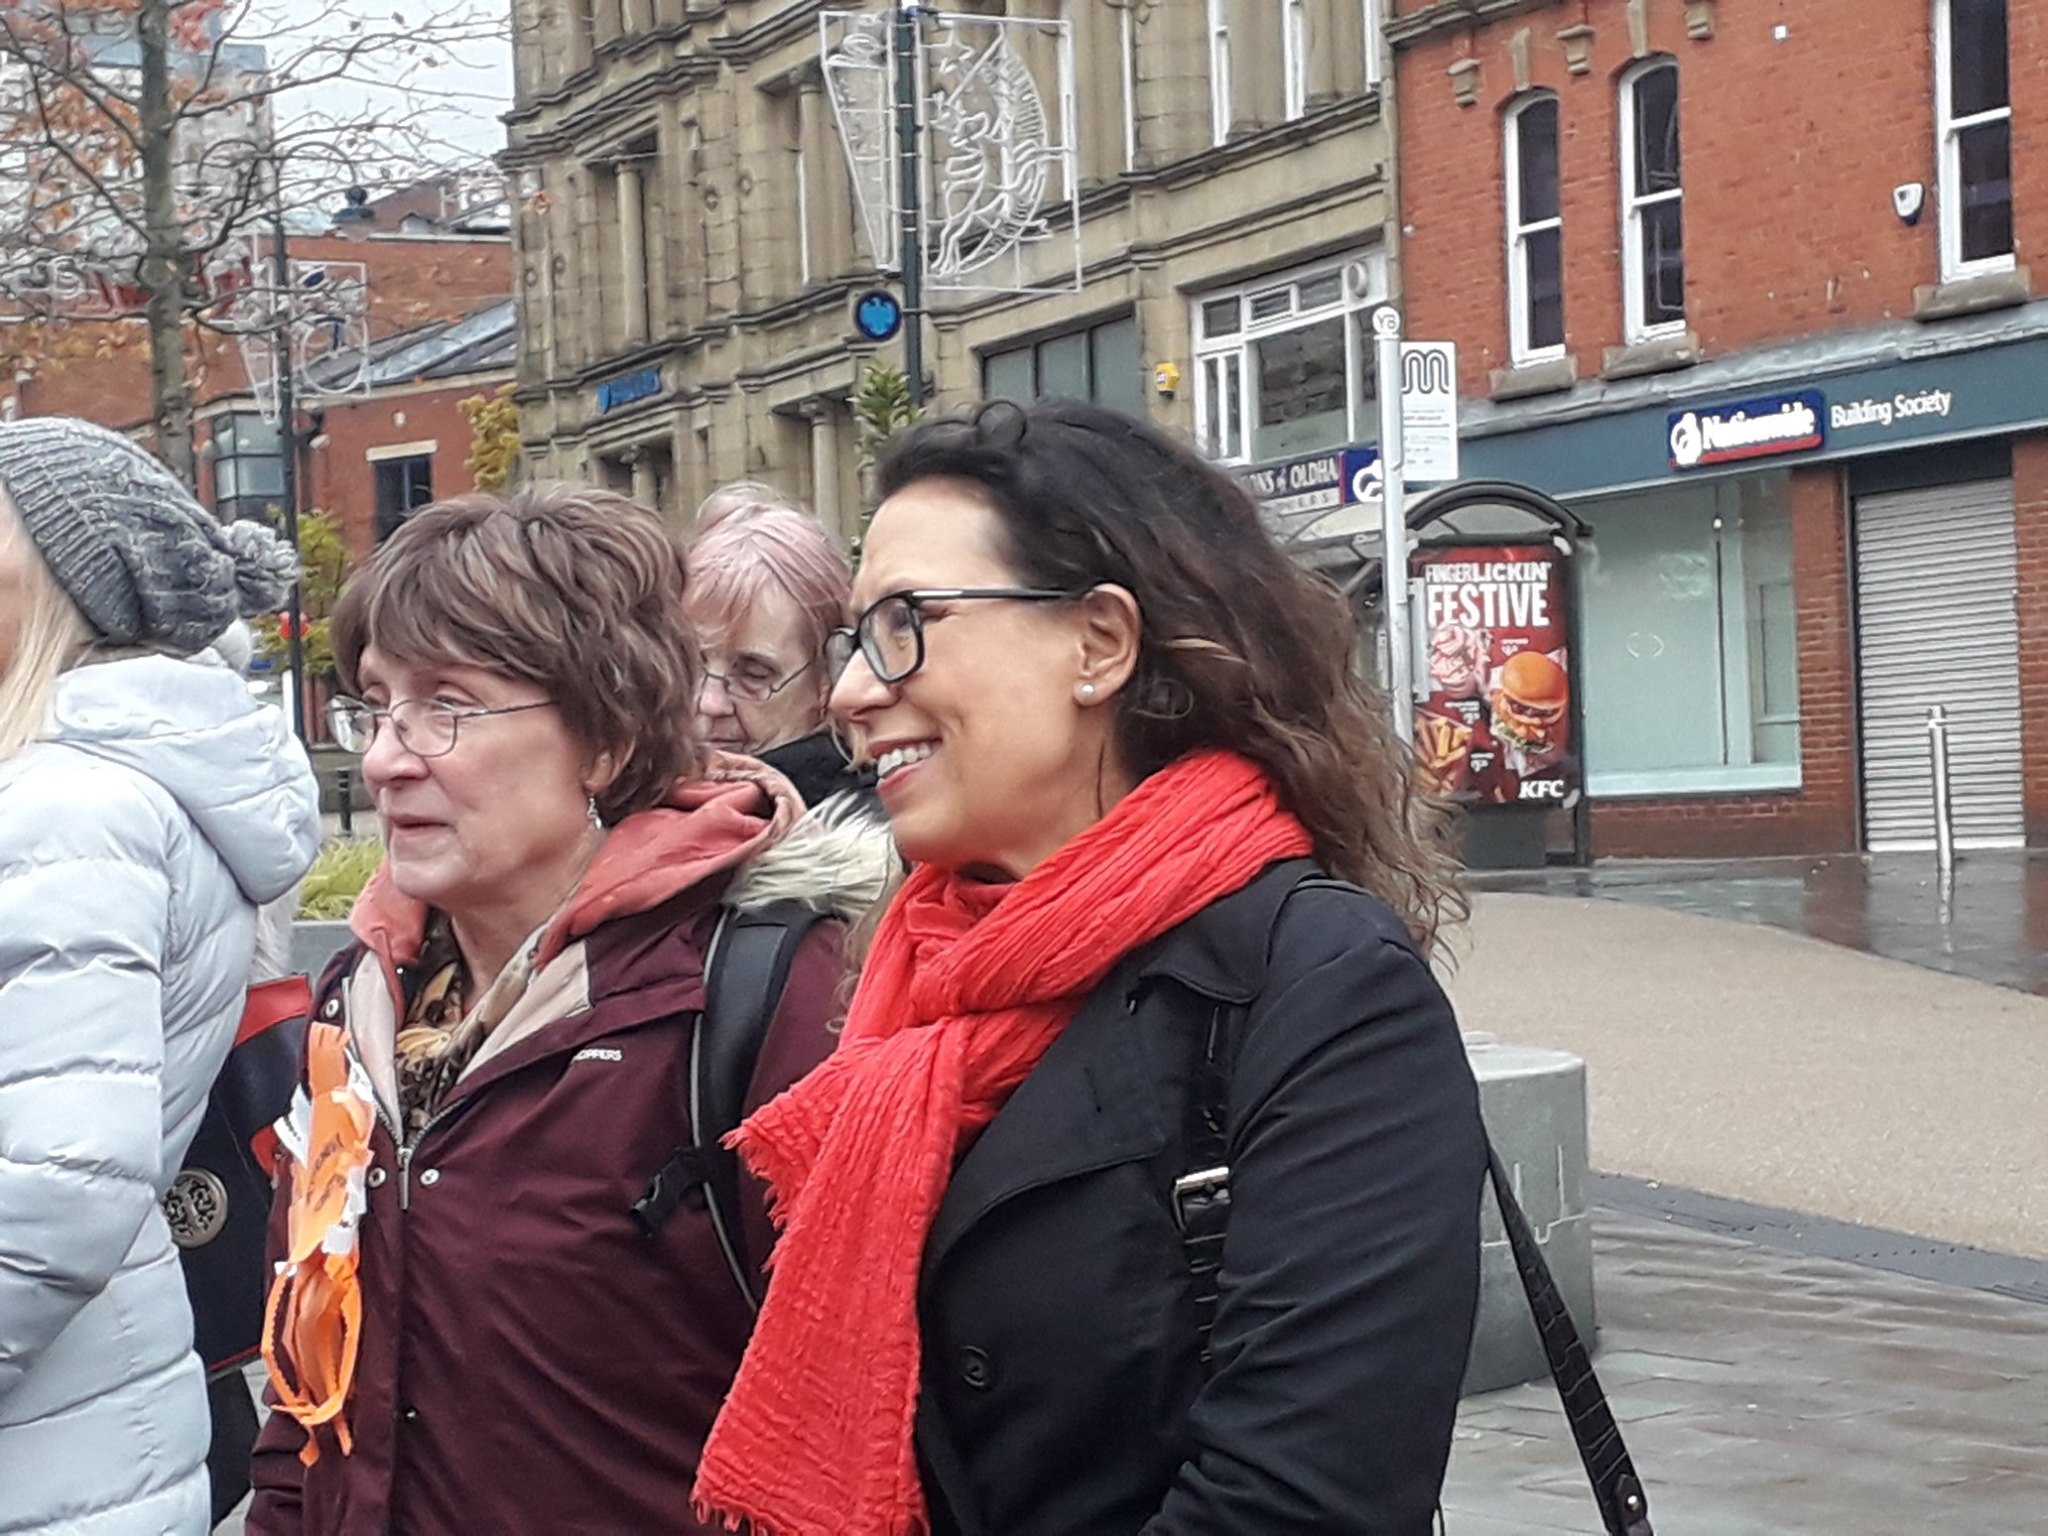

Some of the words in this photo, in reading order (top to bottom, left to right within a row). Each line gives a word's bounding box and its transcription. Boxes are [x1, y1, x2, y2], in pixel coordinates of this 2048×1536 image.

[1702, 401, 1816, 449] Nationwide
[1831, 399, 1892, 428] Building
[1894, 389, 1952, 417] Society
[1427, 583, 1551, 627] FESTIVE
[1518, 779, 1565, 798] KFC
